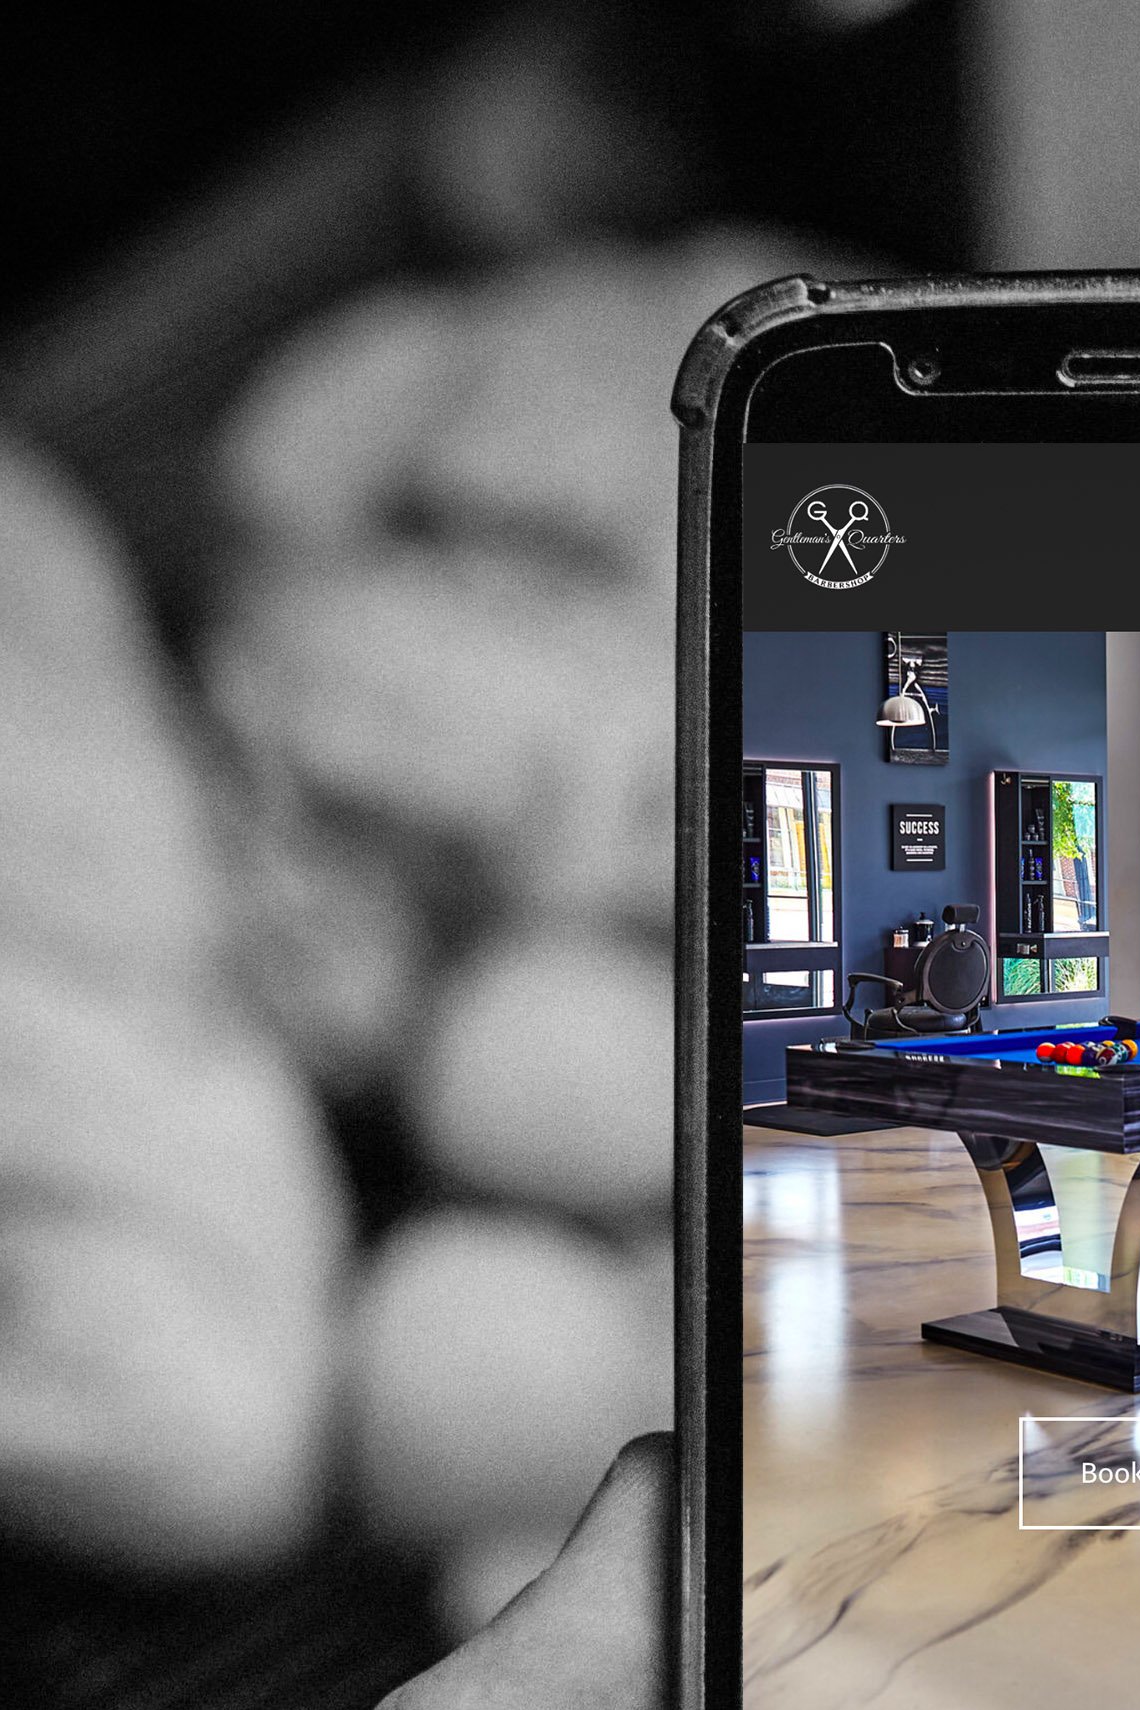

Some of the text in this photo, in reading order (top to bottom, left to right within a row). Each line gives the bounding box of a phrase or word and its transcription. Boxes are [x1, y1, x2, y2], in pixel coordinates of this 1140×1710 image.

[770, 528, 907, 550] Gentleman's Quarters
[807, 574, 871, 589] BARBERSHOP
[899, 821, 940, 835] SUCCESS
